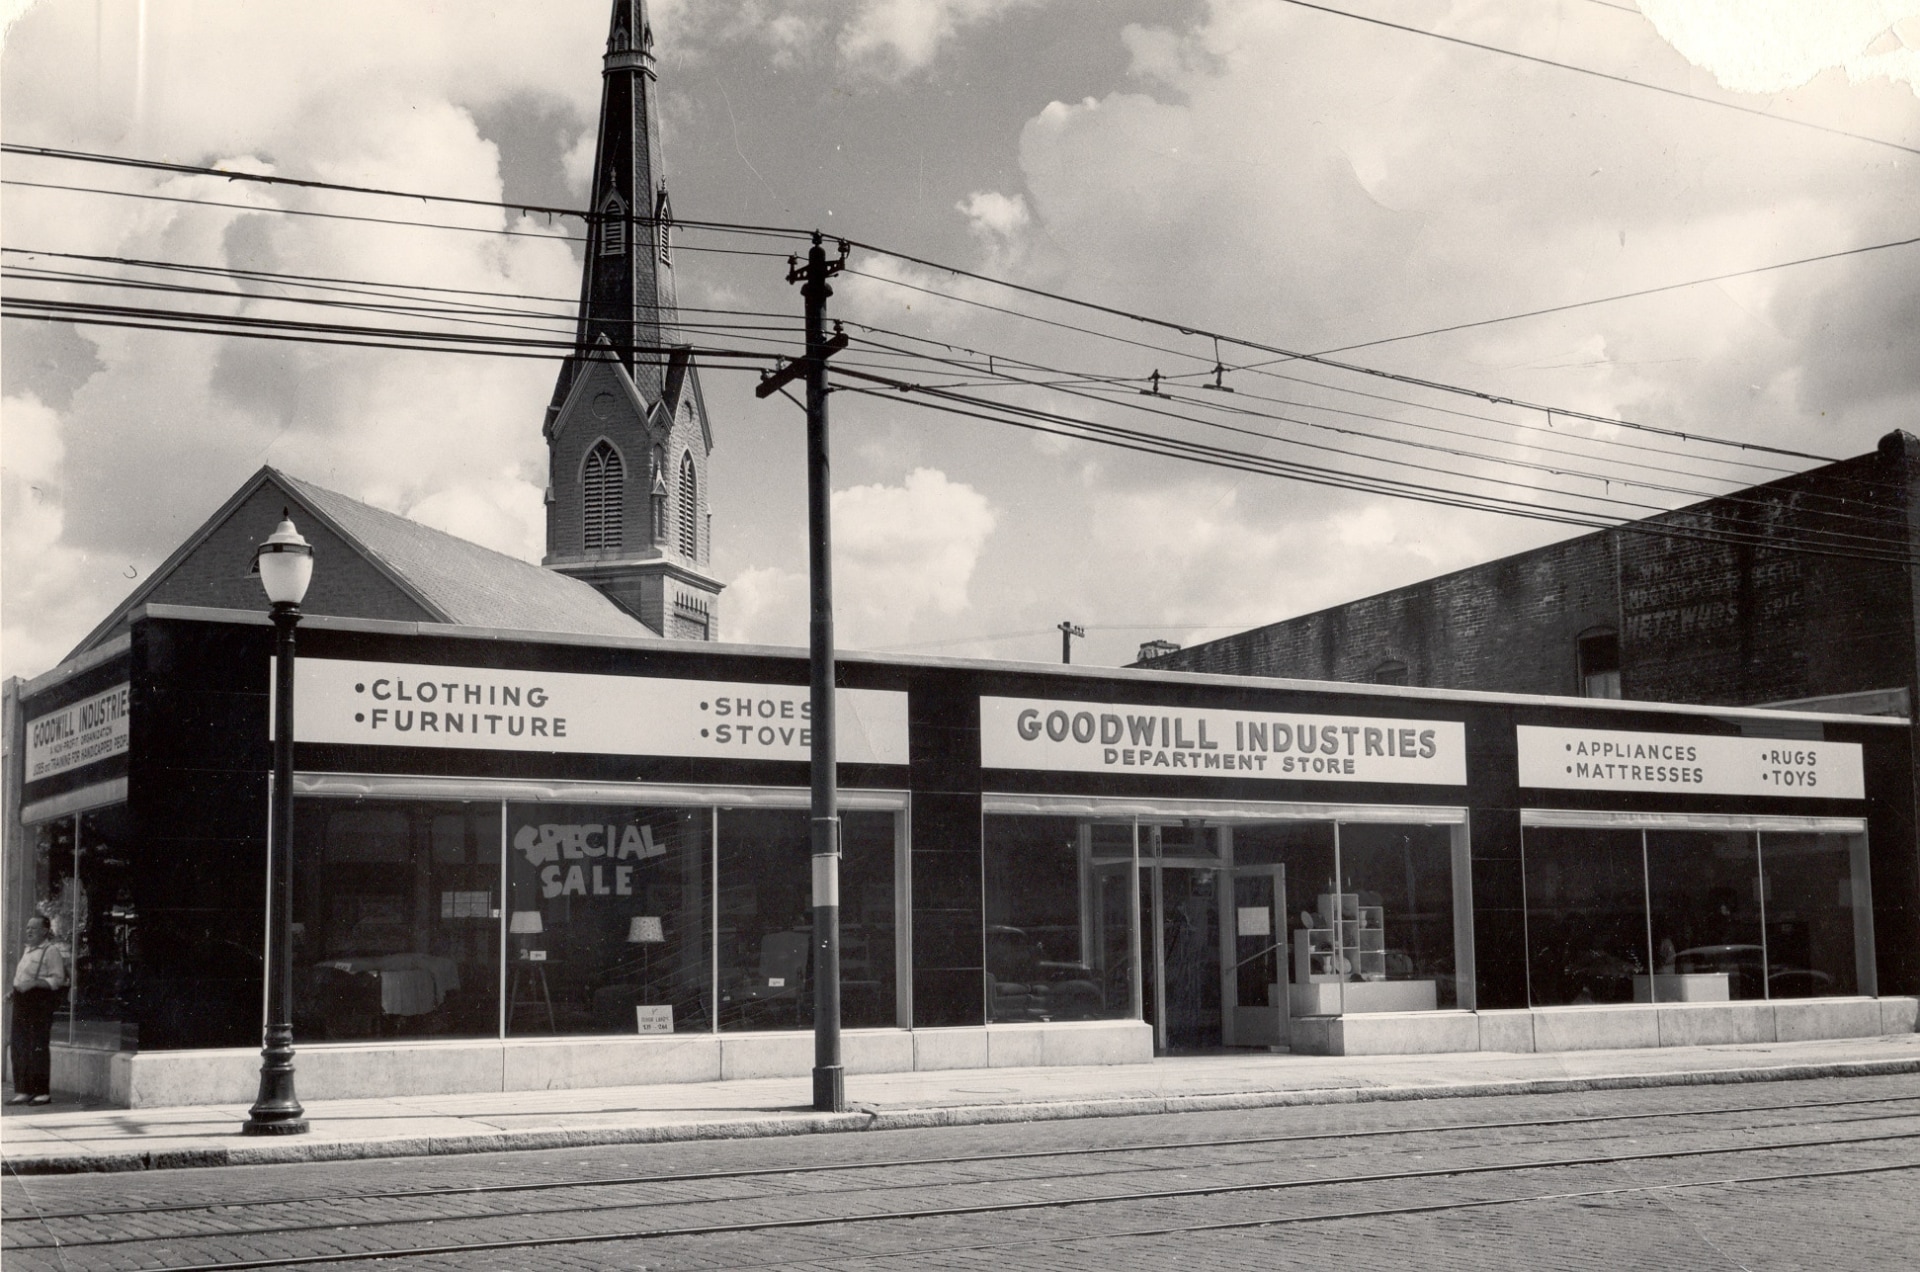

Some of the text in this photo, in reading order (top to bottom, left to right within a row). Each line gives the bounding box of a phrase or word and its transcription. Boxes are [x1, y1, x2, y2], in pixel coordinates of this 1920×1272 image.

[371, 678, 549, 708] CLOTHING
[715, 697, 812, 720] SHOES
[33, 711, 74, 749] GOODWILL
[371, 708, 567, 738] FURNITURE
[715, 724, 812, 747] STOVE
[1017, 708, 1437, 759] GOODWILL INDUSTRIES
[1104, 748, 1355, 775] DEPARTMENT STORE
[1576, 741, 1697, 762] APPLIANCES
[1770, 749, 1817, 767] RUGS
[1576, 763, 1703, 784] MATTRESSES
[1771, 769, 1817, 787] TOYS
[513, 823, 667, 868] SPECIAL
[540, 864, 633, 899] SALE
